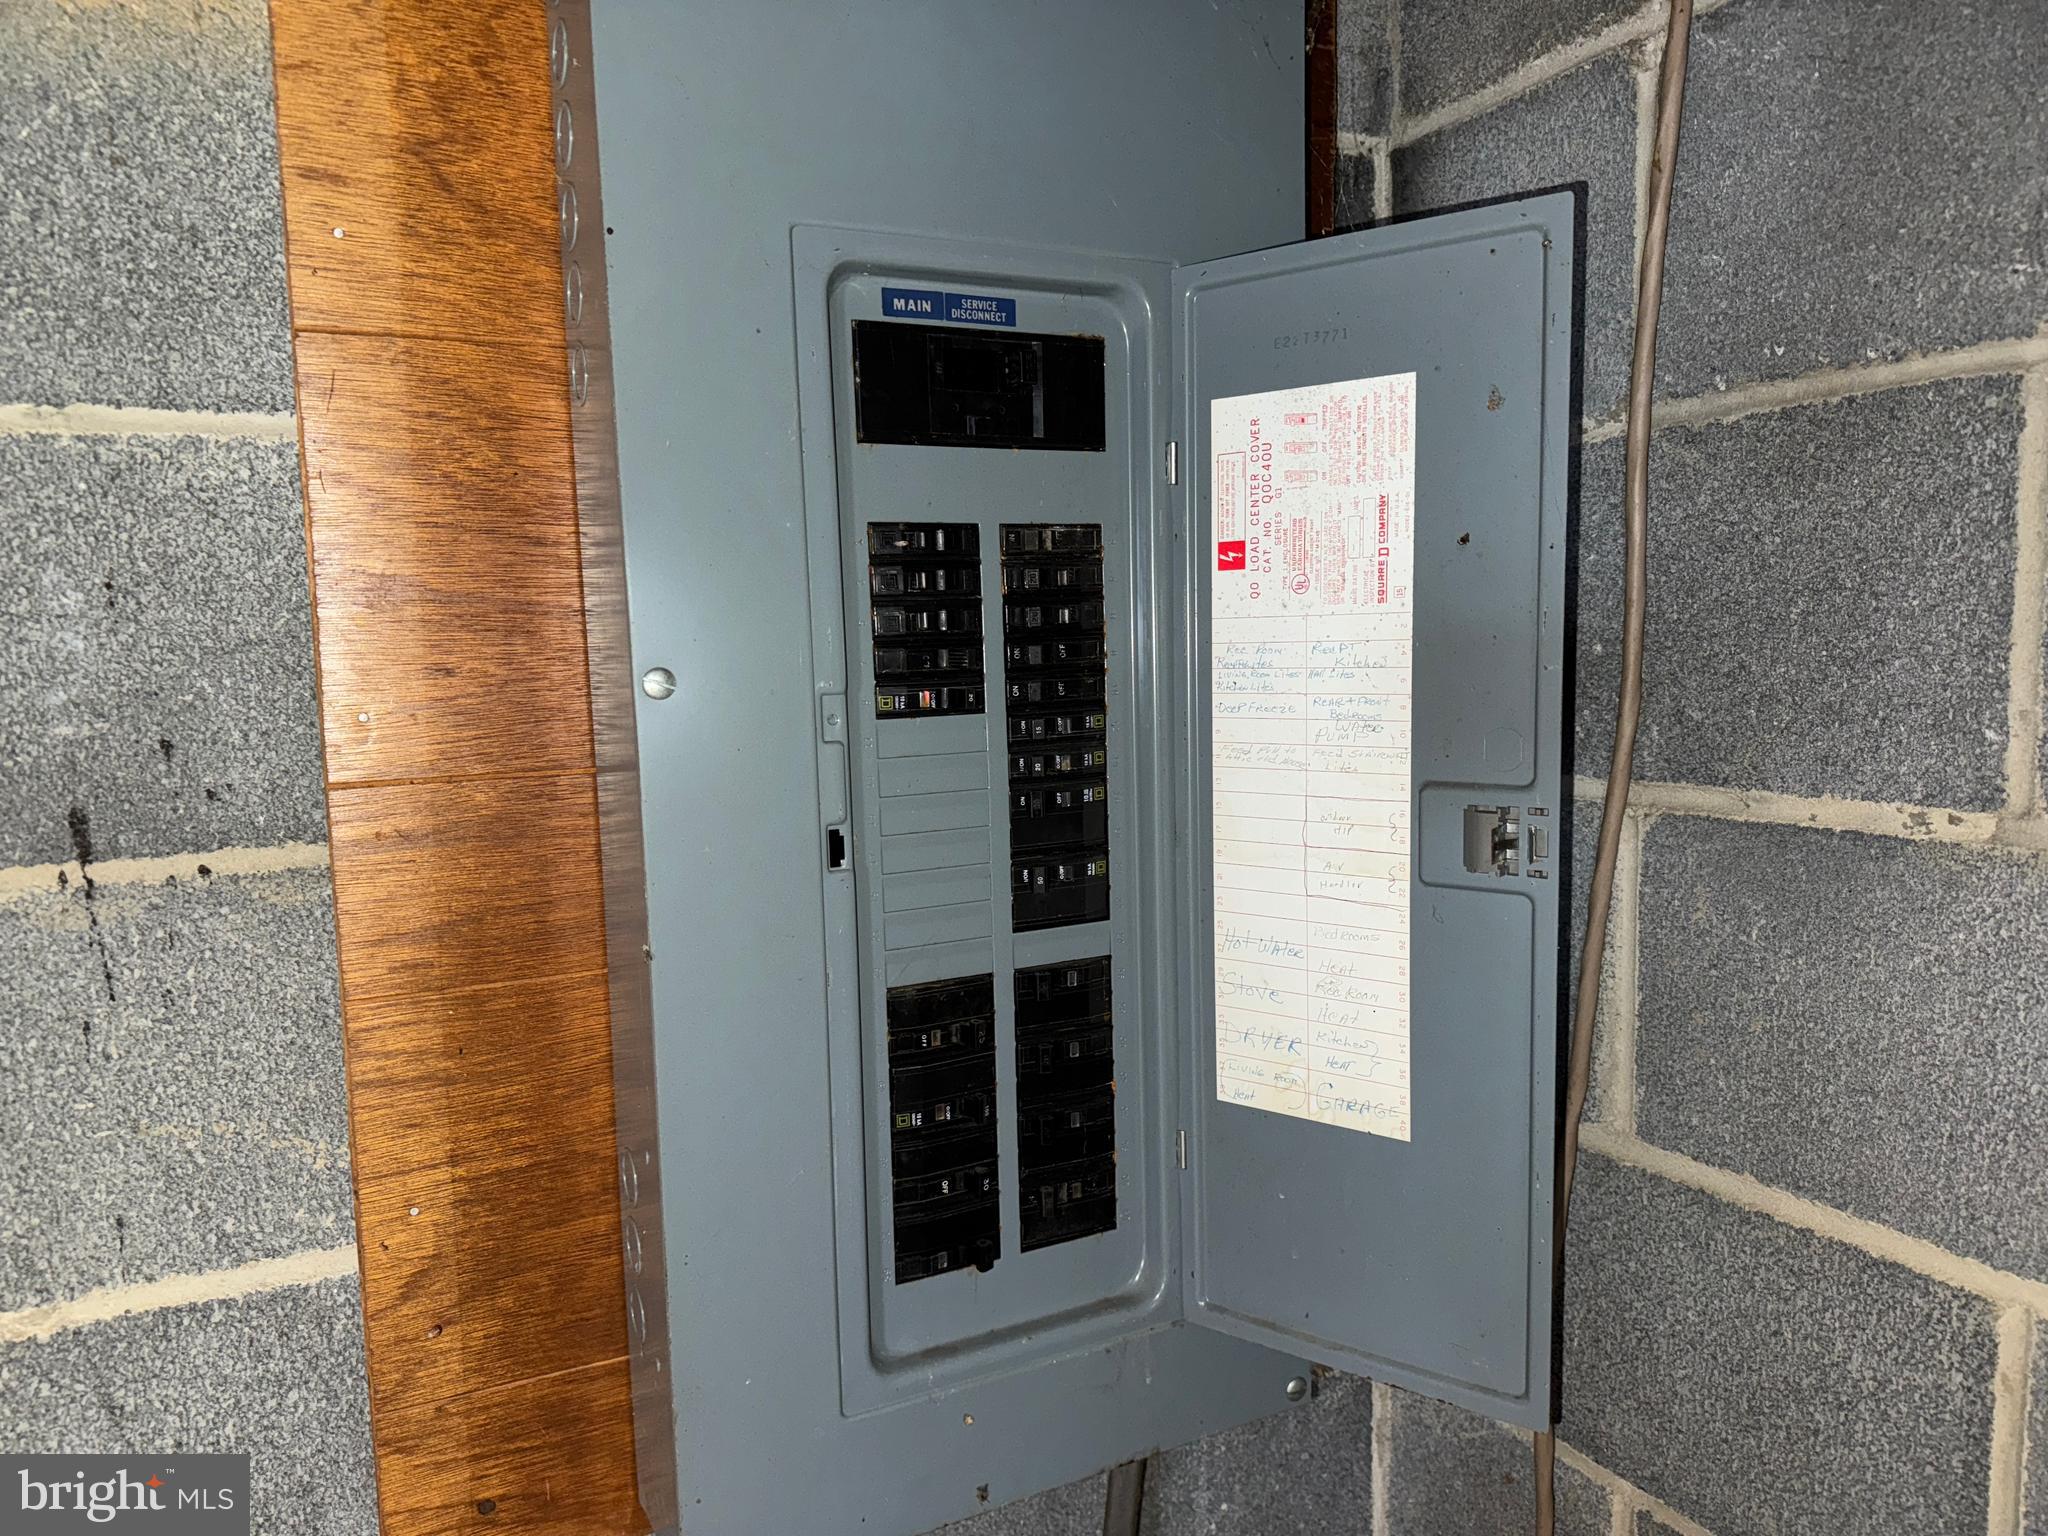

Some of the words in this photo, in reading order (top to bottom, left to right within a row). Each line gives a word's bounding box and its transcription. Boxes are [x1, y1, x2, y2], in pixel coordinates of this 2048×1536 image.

[892, 297, 932, 313] MAIN
[960, 298, 998, 311] SERVICE
[951, 308, 1007, 323] DISCONNECT
[1250, 418, 1260, 463] COVER
[1250, 474, 1260, 526] CENTER
[1378, 494, 1386, 544] COMPANY
[1274, 512, 1283, 546] SERIES
[1250, 536, 1260, 572] LOAD
[1263, 546, 1272, 573] CAT.
[1378, 547, 1389, 557] D
[1250, 582, 1261, 600] QO
[1014, 647, 1021, 659] ON
[1058, 644, 1067, 658] OFF
[968, 692, 974, 702] 20
[1012, 685, 1020, 697] ON
[1036, 726, 1042, 734] 15
[1035, 763, 1041, 772] 20
[1020, 796, 1026, 806] ON
[1218, 972, 1284, 1004] Stove
